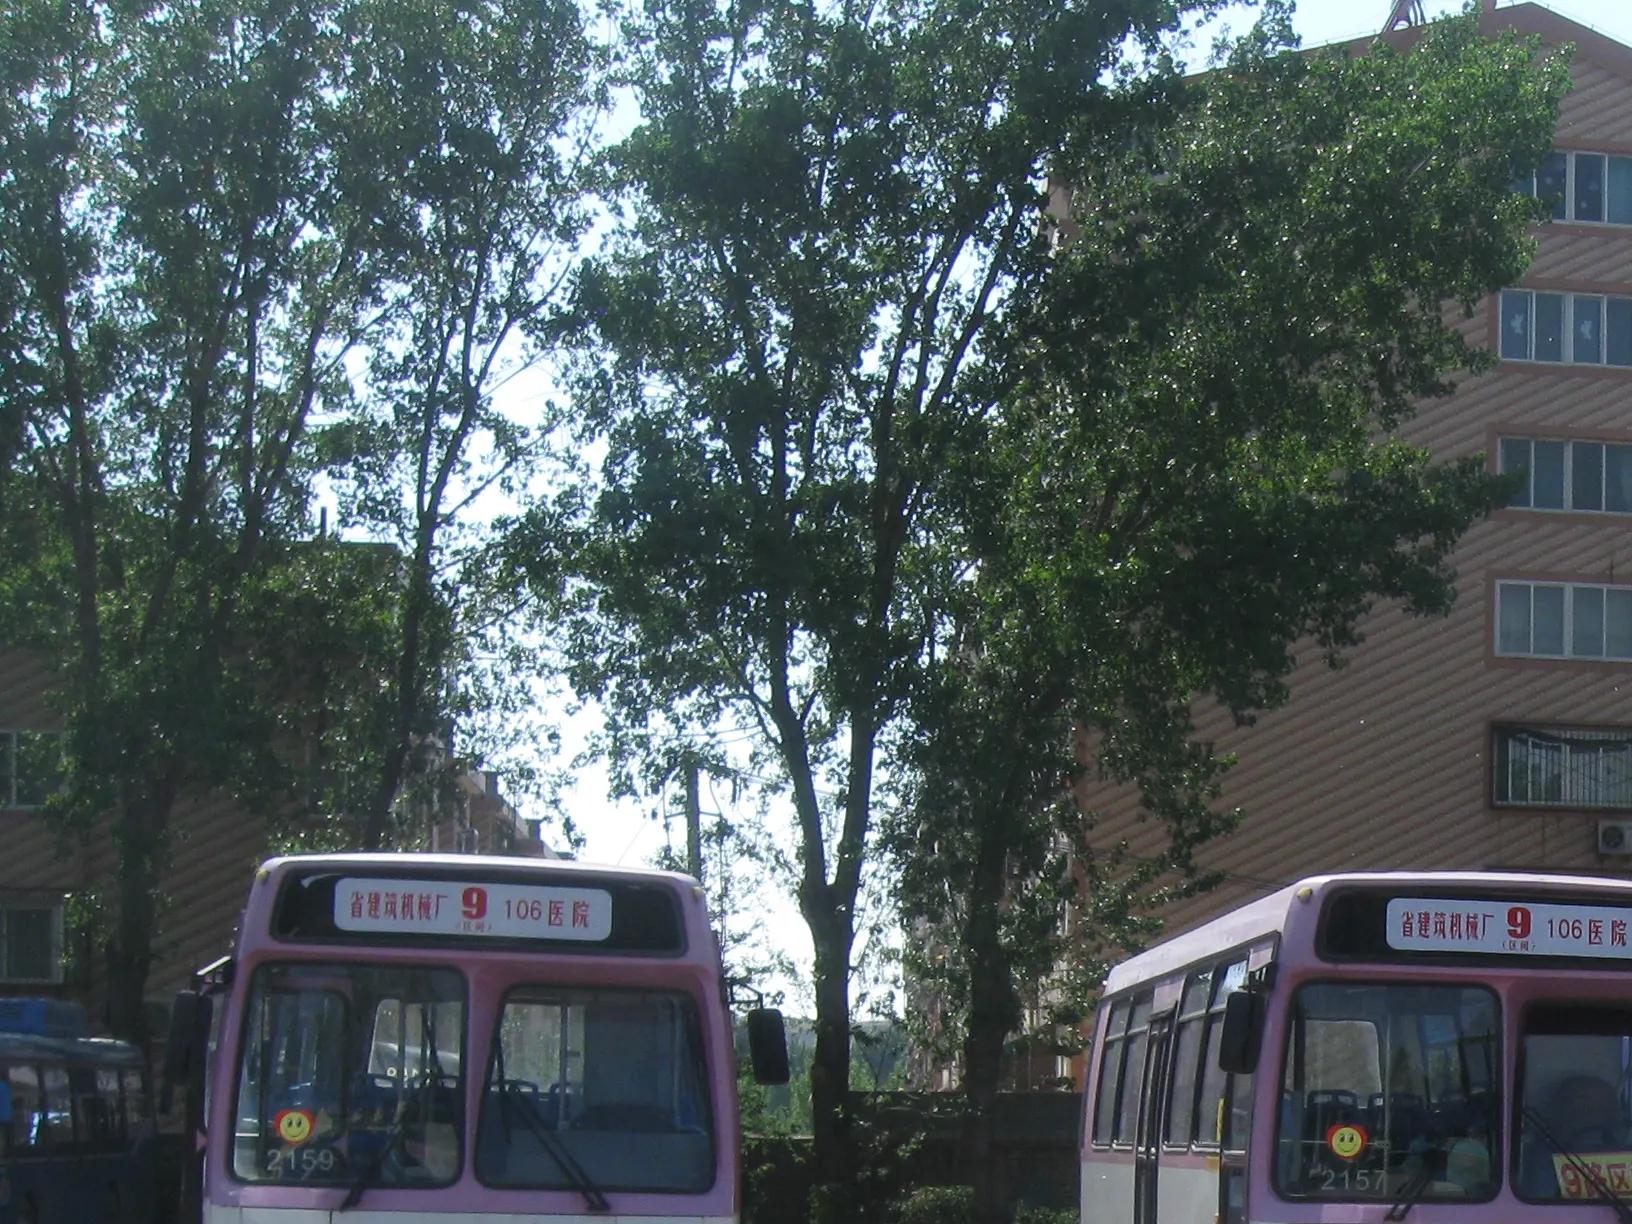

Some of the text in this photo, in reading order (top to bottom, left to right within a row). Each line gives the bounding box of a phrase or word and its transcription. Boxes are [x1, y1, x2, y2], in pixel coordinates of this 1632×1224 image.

[462, 887, 488, 920] 9
[1401, 911, 1495, 940] 省建筑机械厂
[1507, 906, 1532, 939] 9
[266, 1149, 334, 1171] 2159
[1321, 1169, 1386, 1190] 2157
